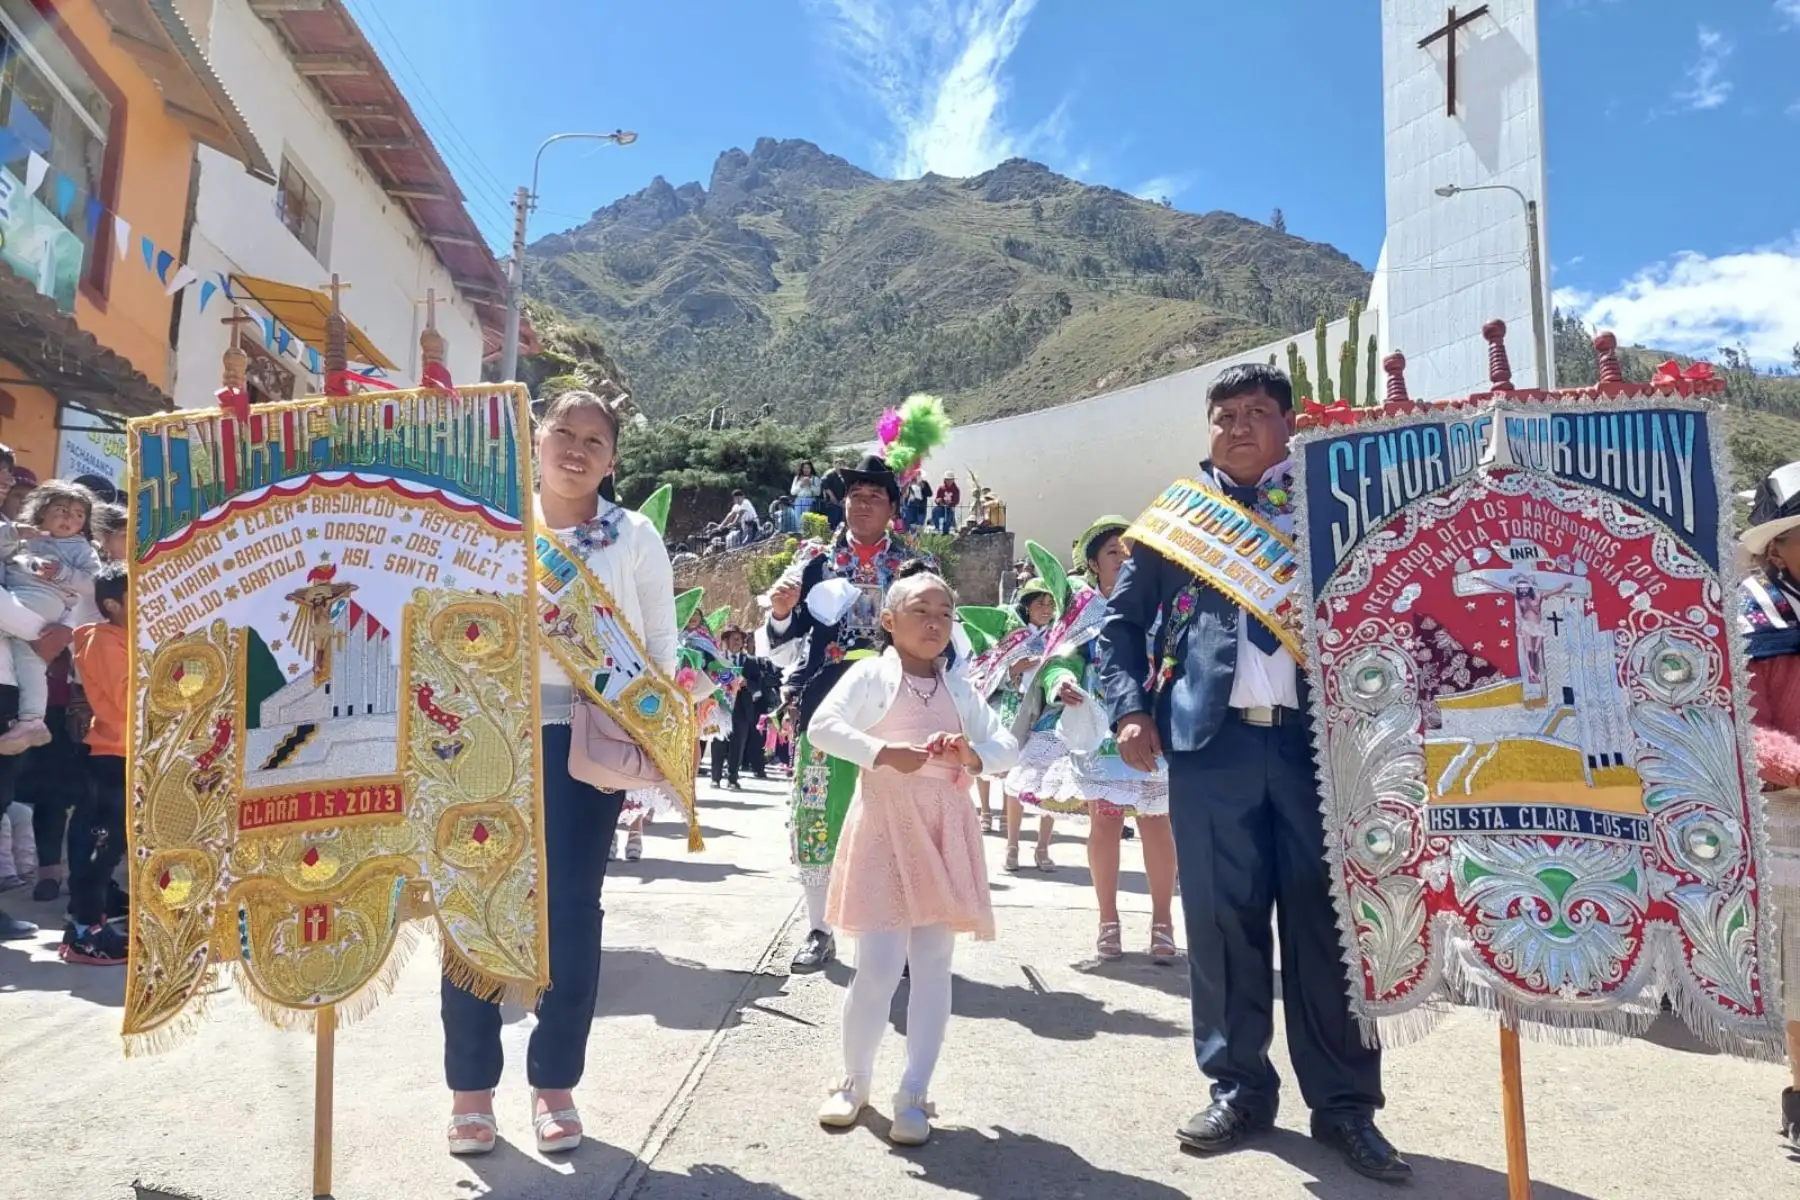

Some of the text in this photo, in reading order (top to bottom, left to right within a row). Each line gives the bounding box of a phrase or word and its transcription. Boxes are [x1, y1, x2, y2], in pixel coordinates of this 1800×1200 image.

[279, 406, 325, 476] DE
[1450, 416, 1495, 477] DE
[1504, 413, 1695, 534] MURUHUAY
[234, 527, 303, 568] BARTOLO
[324, 522, 388, 545] OROSCO
[1362, 499, 1667, 614] RECUERDO DE LOS MAYORDOMOS 2016
[1421, 519, 1623, 586] FAMILIA TORRES MUCHA
[1510, 546, 1539, 560] INRI
[147, 589, 223, 644] BASUALDO
[238, 550, 306, 595] BARTOLO
[383, 553, 440, 583] SANTA
[242, 797, 299, 827] CLARA
[1518, 806, 1580, 832] CLARA
[1589, 815, 1649, 841] 1-05-16
